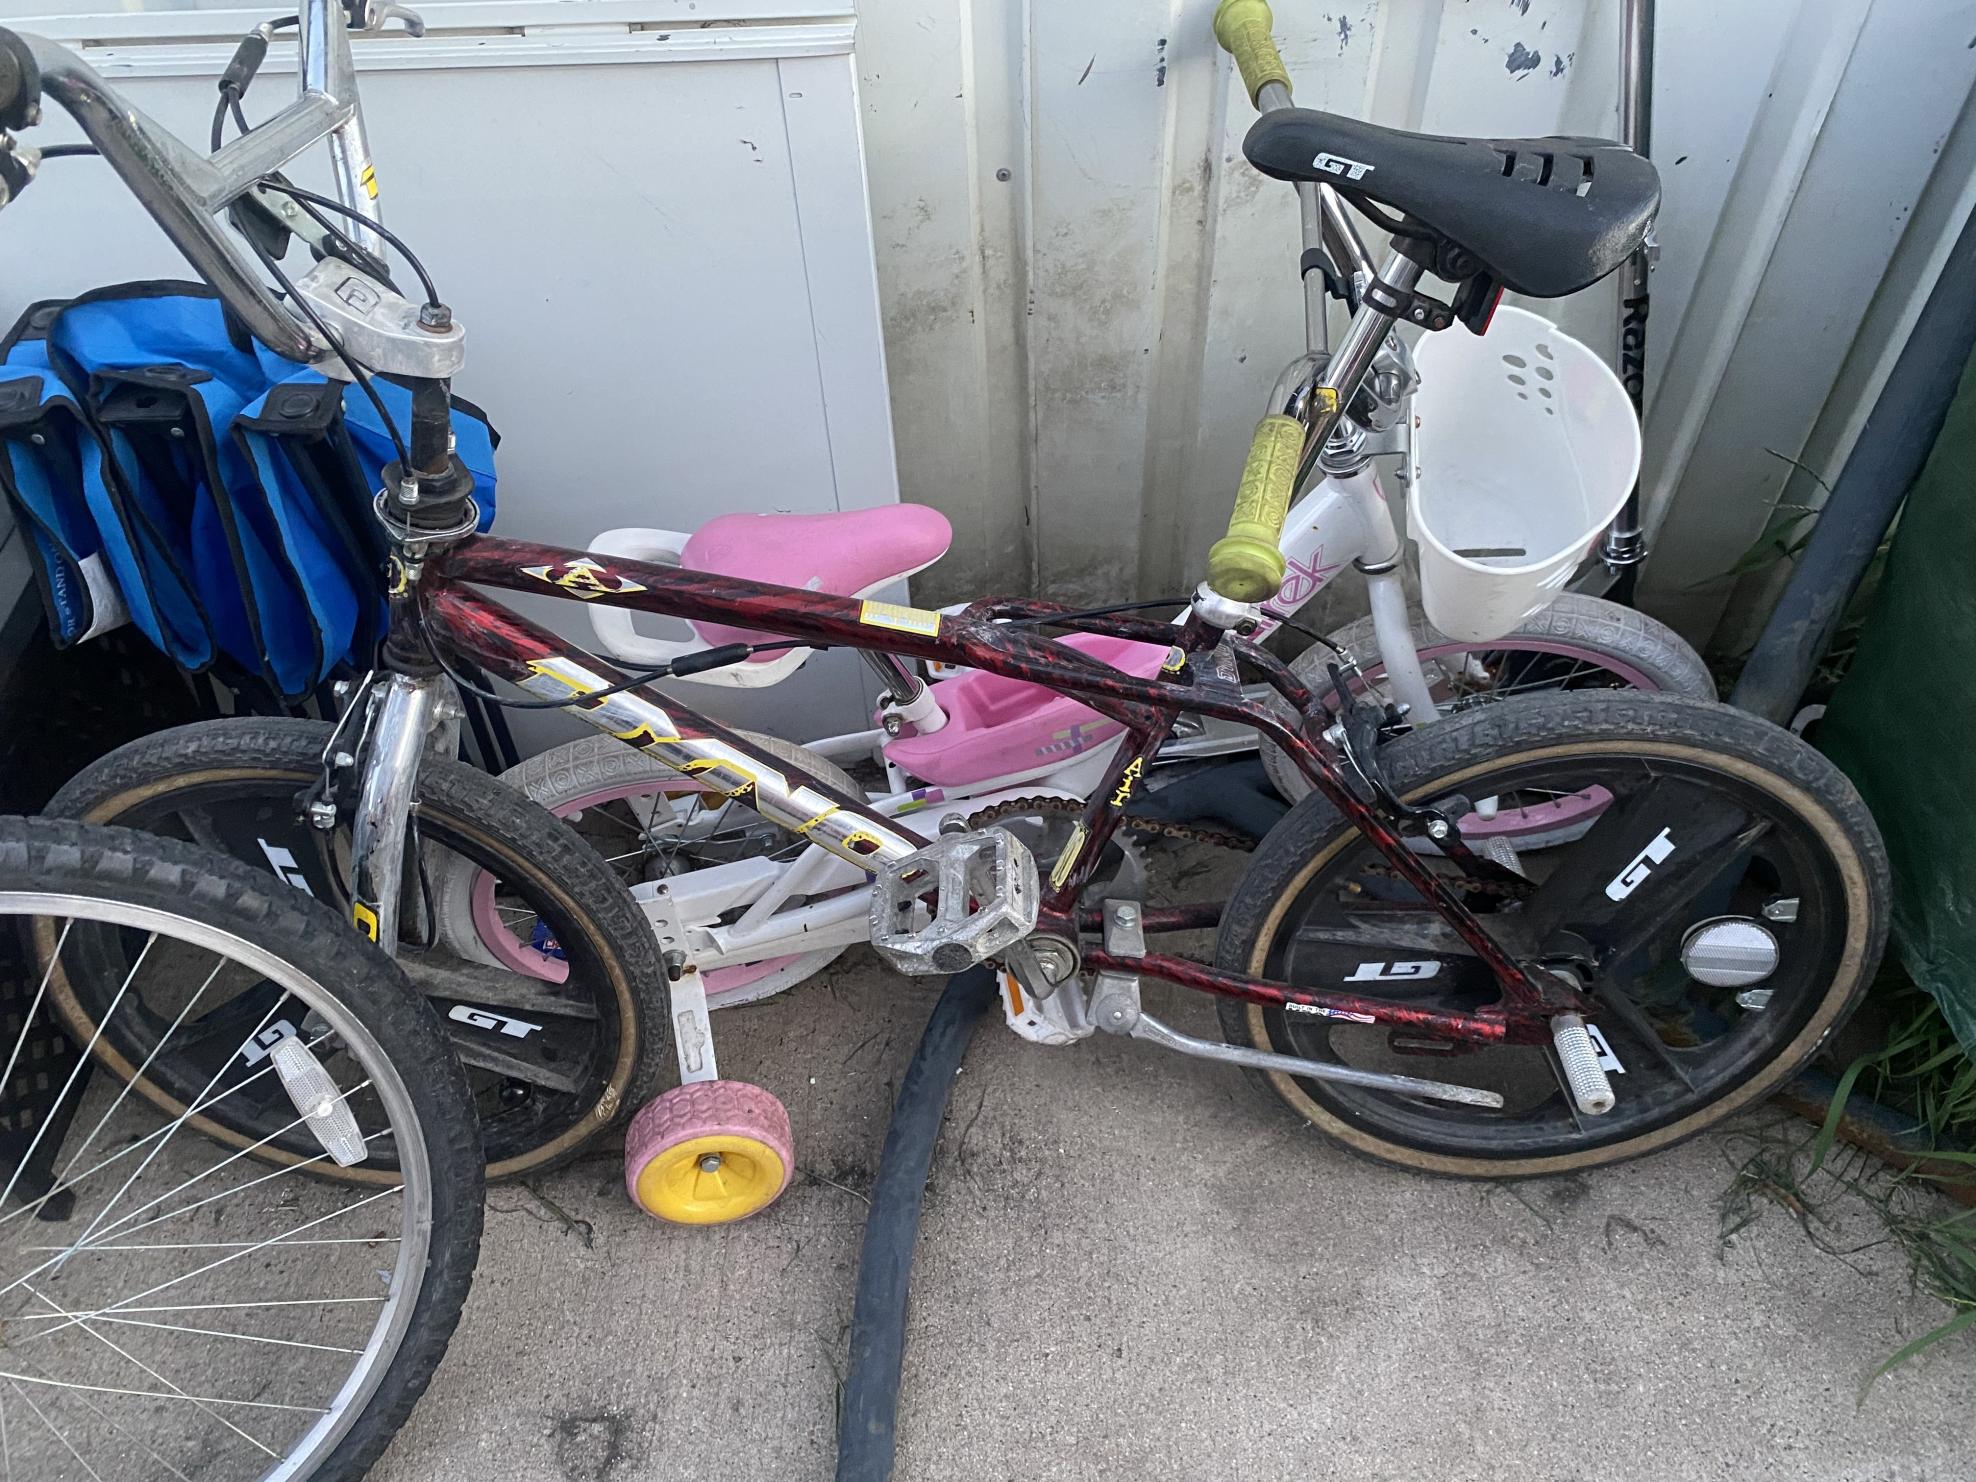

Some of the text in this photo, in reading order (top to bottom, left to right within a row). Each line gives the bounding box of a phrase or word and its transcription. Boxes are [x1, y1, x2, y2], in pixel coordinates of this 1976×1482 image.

[1311, 152, 1376, 181] GT
[1622, 293, 1650, 402] Razo
[1605, 826, 1676, 902] GT
[1343, 960, 1442, 982] GT
[447, 1005, 543, 1039] GT
[239, 1019, 298, 1068] GT
